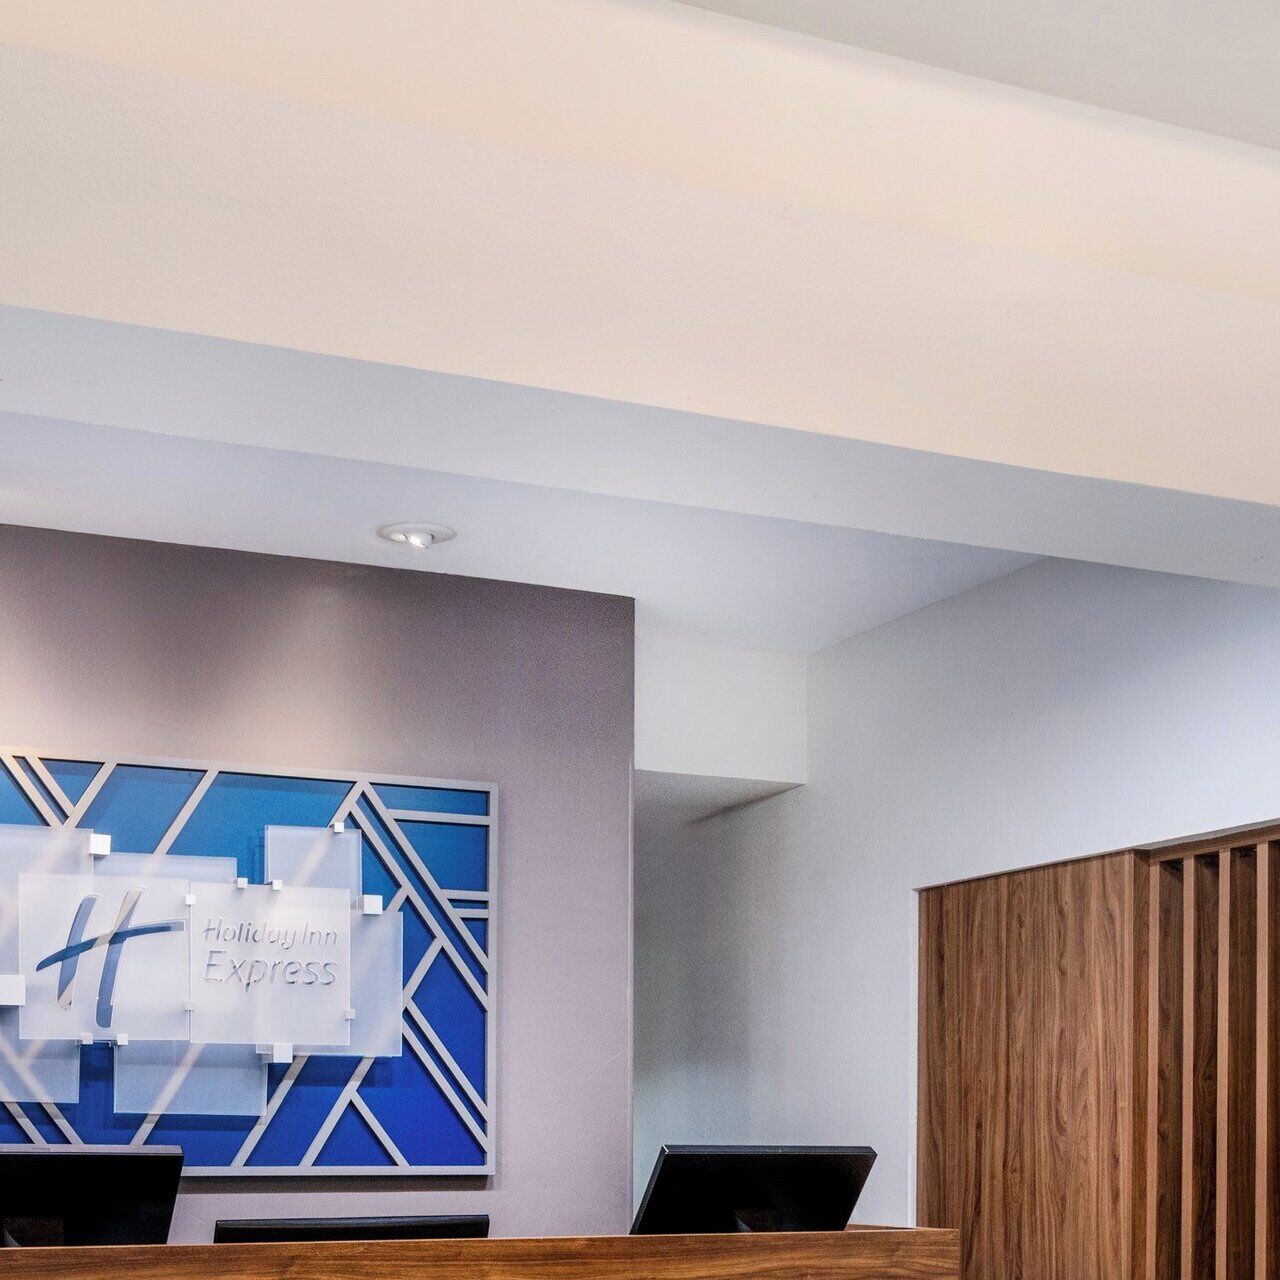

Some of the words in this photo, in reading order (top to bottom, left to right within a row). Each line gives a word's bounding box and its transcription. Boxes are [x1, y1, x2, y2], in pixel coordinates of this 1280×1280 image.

[203, 918, 297, 950] Holiday
[302, 922, 338, 946] Inn
[203, 950, 339, 992] Express
